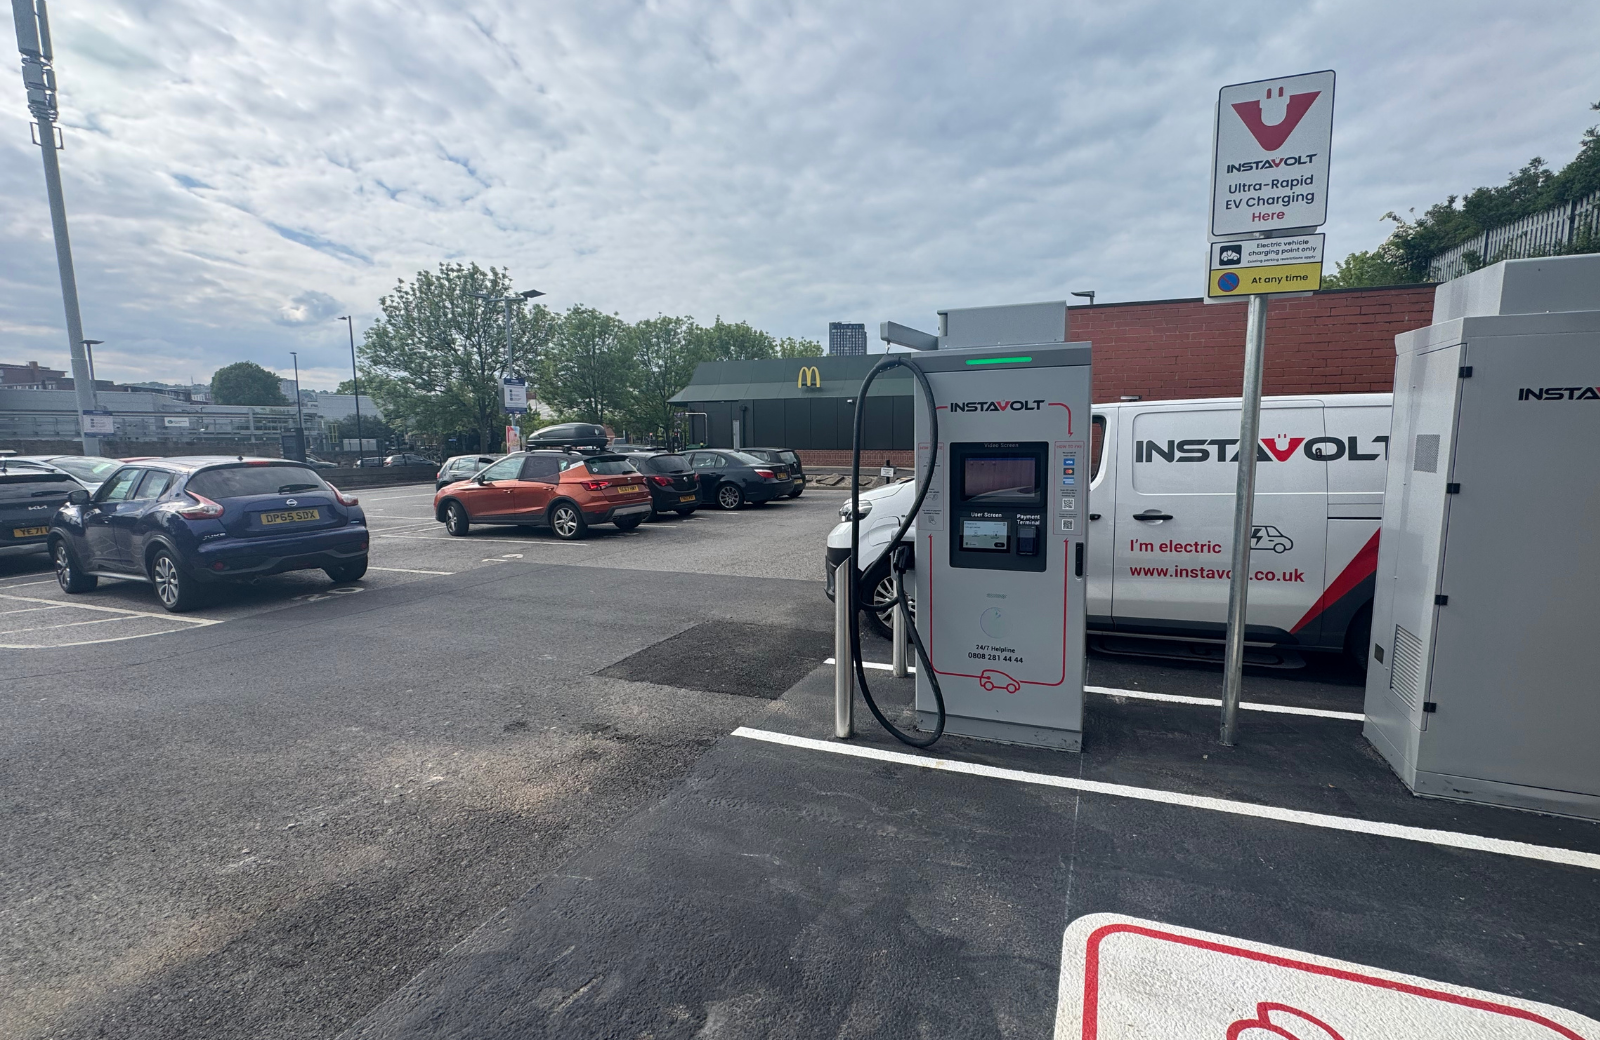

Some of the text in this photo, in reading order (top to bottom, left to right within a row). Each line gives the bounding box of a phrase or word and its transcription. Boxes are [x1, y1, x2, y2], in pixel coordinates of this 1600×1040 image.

[1226, 153, 1318, 174] INSTAVOLT
[1228, 174, 1314, 194] Ultra-Rapid
[1225, 192, 1315, 210] EV Charging
[1251, 211, 1286, 222] Here
[1248, 245, 1317, 257] charging point only
[1256, 241, 1282, 249] Electric
[1251, 273, 1309, 284] At any time
[1518, 387, 1600, 401] INSTA
[950, 399, 1046, 413] INSTAVOLT
[266, 510, 316, 523] DP65 SDX
[1130, 538, 1222, 554] I’m electric
[1129, 564, 1305, 582] www.instav.co.uk
[991, 645, 1016, 654] Helpline
[968, 651, 986, 660] 0808
[987, 653, 1001, 661] 281
[1014, 656, 1024, 664] 44
